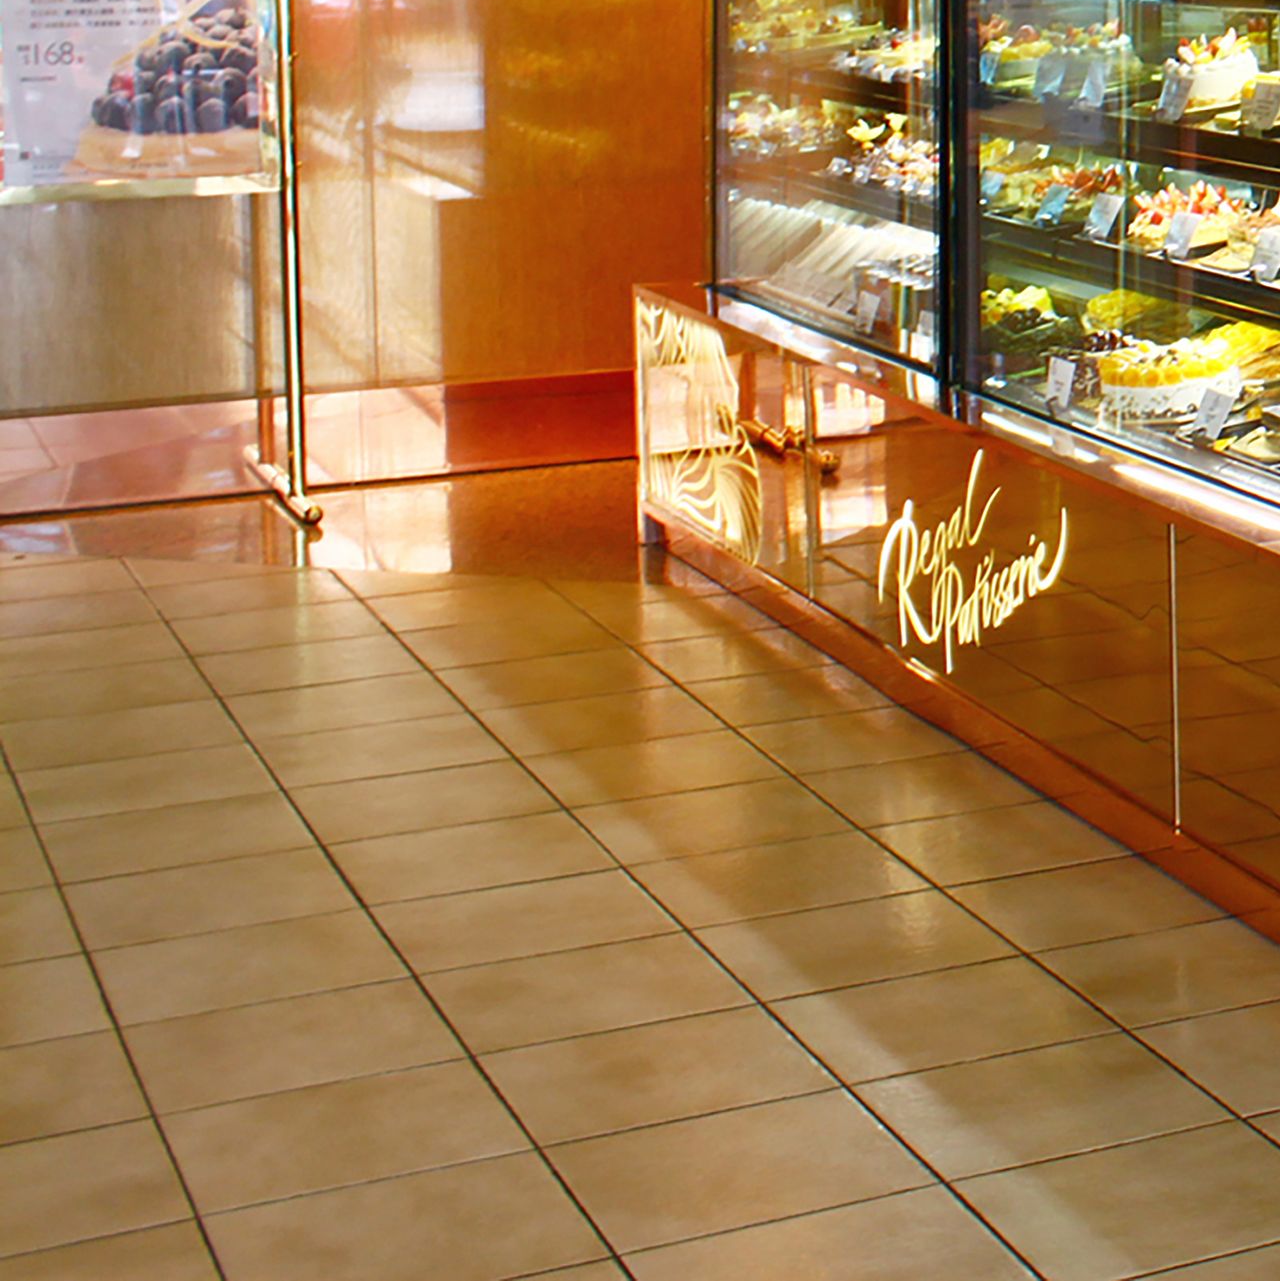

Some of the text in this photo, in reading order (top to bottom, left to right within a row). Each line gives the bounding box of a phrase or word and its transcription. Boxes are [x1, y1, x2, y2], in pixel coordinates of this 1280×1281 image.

[33, 41, 75, 66] 168
[879, 448, 1002, 648] Regal
[931, 506, 1069, 675] Patisserie
